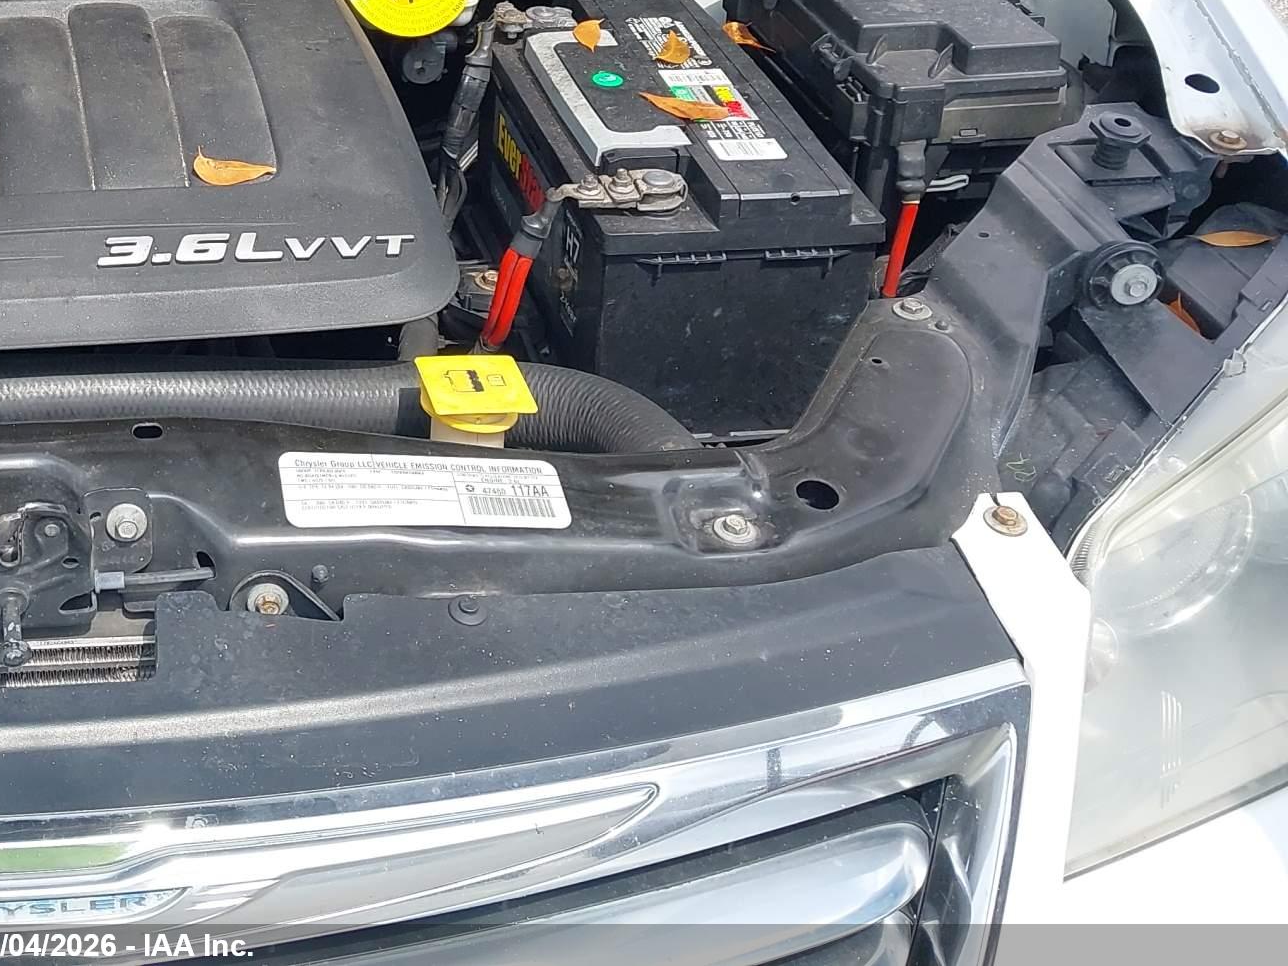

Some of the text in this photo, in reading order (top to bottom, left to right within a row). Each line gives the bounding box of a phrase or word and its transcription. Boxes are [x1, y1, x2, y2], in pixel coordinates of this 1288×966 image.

[96, 232, 415, 268] 3.6L VVT
[294, 459, 328, 469] Chrysler
[330, 460, 354, 468] Group
[357, 460, 372, 468] LLC
[376, 461, 407, 469] VEHICLE
[410, 462, 448, 471] EMISSION
[451, 464, 485, 472] CONTROL
[488, 465, 542, 474] INFORMATION
[512, 485, 550, 497] 117AA
